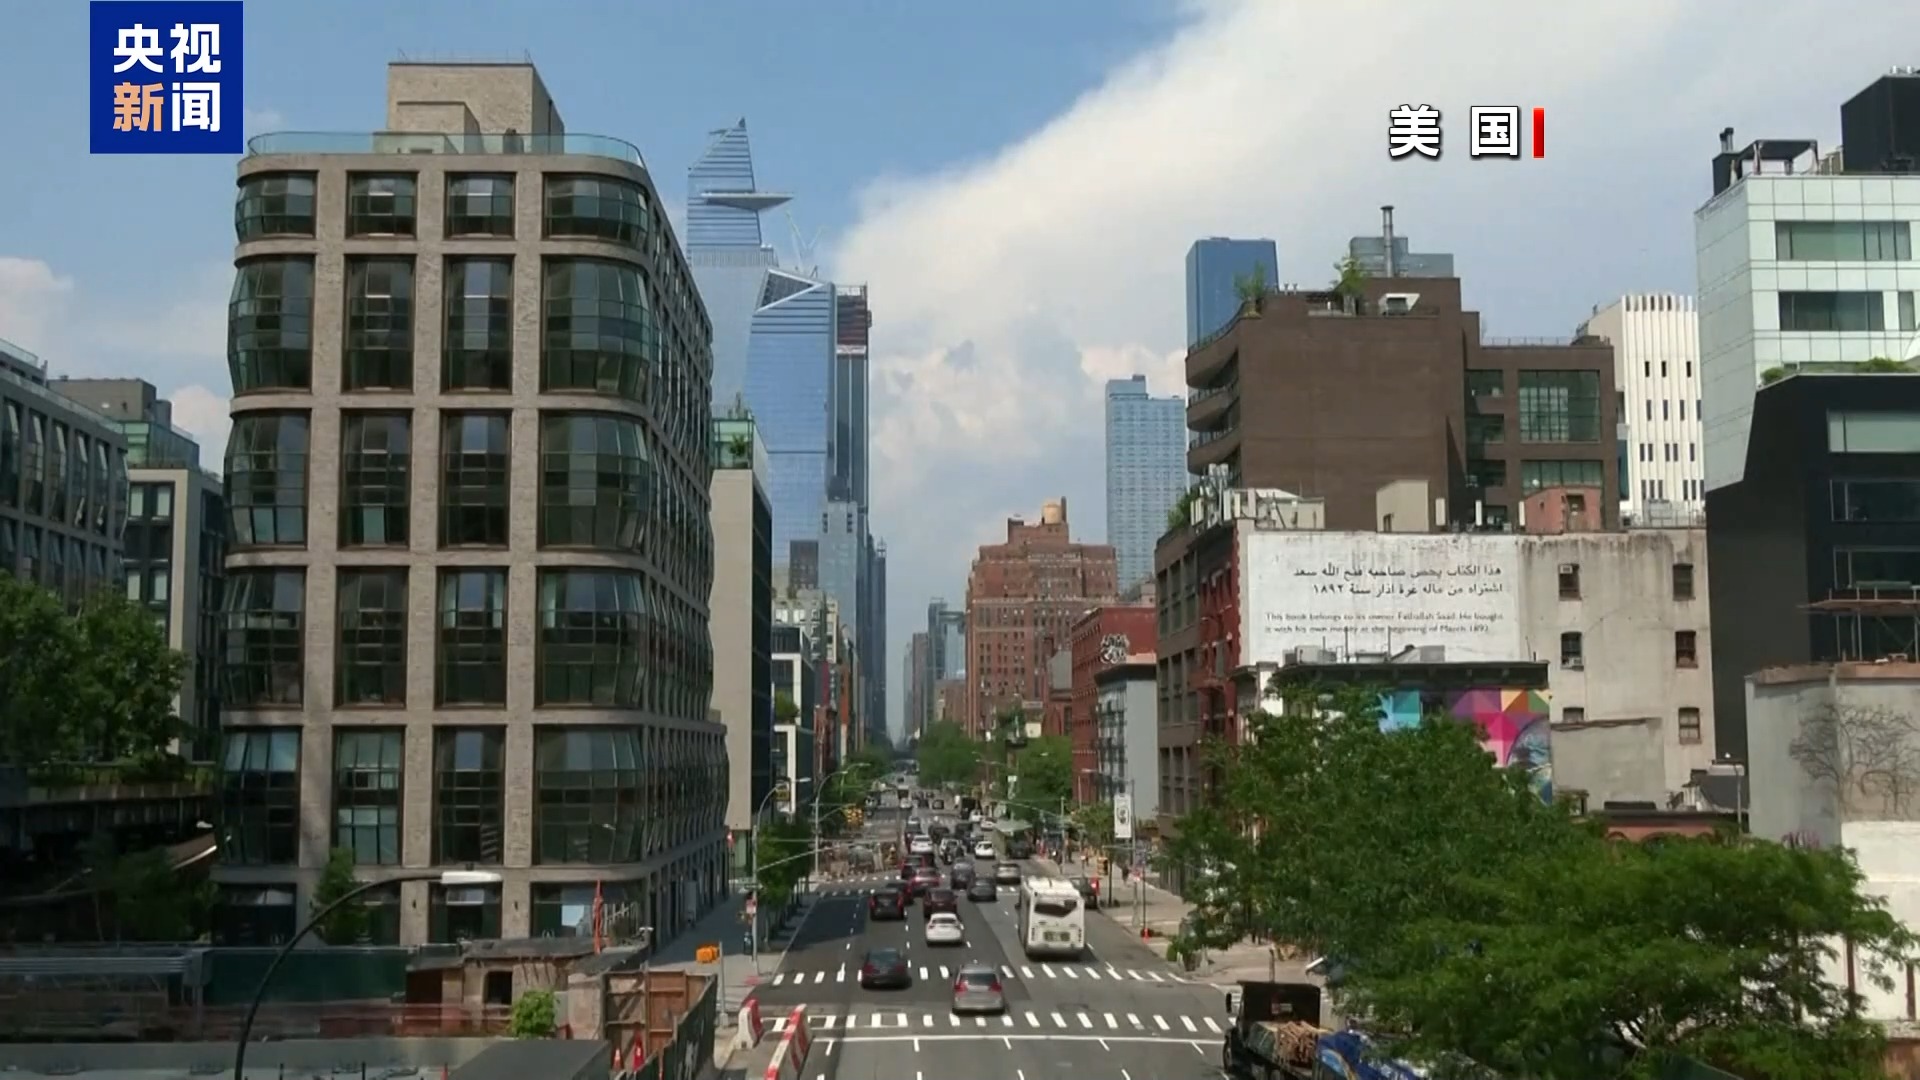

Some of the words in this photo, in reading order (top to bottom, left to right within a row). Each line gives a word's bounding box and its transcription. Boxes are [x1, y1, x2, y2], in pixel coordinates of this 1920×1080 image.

[1293, 567, 1318, 577] سعد
[1321, 562, 1339, 576] الله
[1446, 563, 1481, 577] الكتاب
[1483, 564, 1502, 576] هذا
[1447, 584, 1464, 596] من
[1265, 612, 1283, 620] This
[1286, 612, 1307, 620] book
[1309, 611, 1342, 622] belongs
[1440, 624, 1467, 632] March
